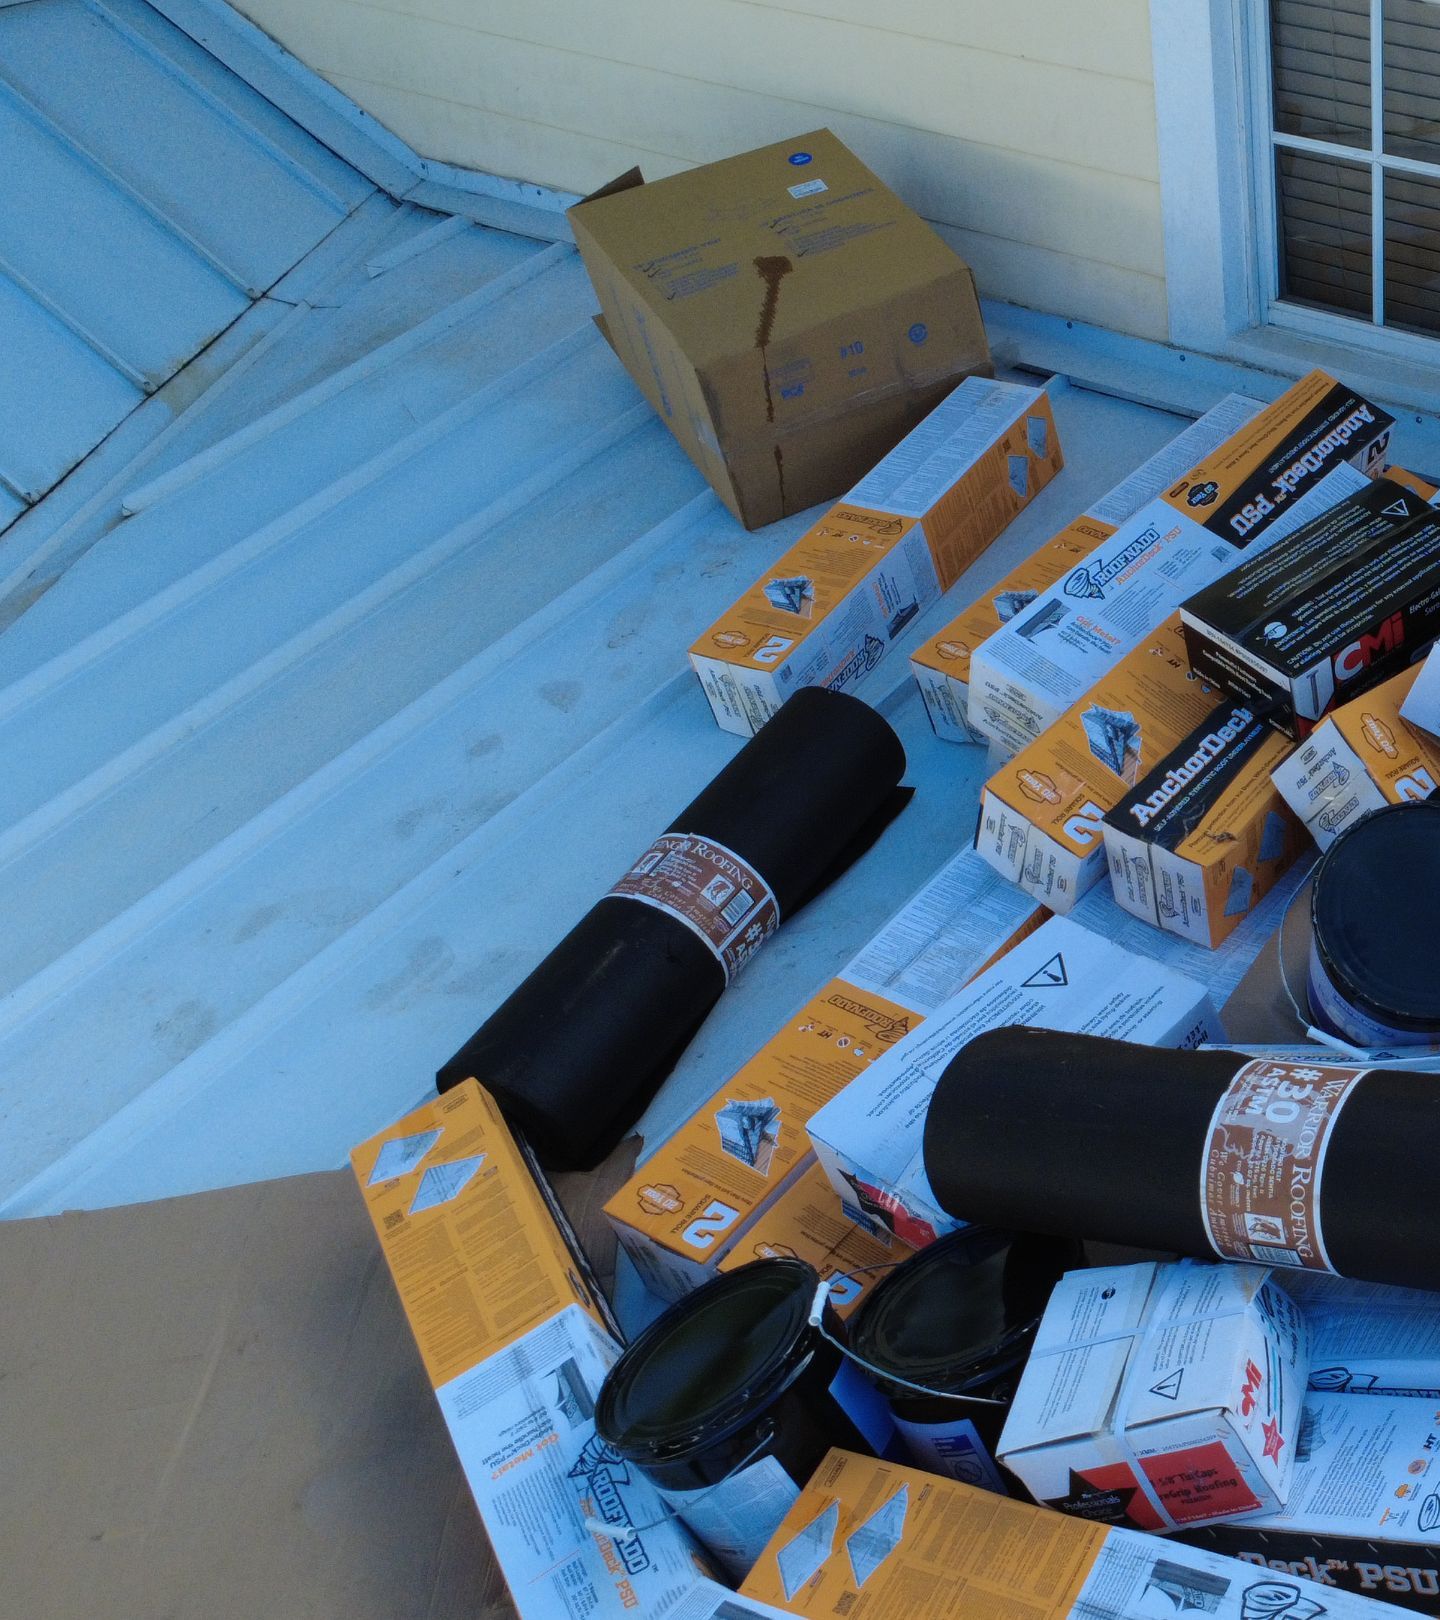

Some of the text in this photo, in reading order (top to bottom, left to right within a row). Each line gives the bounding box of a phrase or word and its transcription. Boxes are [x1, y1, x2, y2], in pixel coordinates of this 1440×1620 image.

[1188, 480, 1215, 506] 20 Year
[1226, 490, 1275, 538] PSU
[1162, 524, 1183, 544] PSU
[751, 636, 795, 664] 2
[1126, 701, 1259, 827] AnchorDeck
[1062, 800, 1106, 846] 2
[692, 842, 754, 890] ROOFING
[825, 990, 895, 1030] ROOFNADO
[815, 1027, 833, 1041] HT
[1244, 1067, 1281, 1117] ASTM
[1266, 1067, 1324, 1124] #30
[1289, 1078, 1350, 1259] WARRIOR ROOFING
[641, 1186, 678, 1211] 20 Year
[681, 1199, 740, 1250] 2
[1063, 1494, 1121, 1513] Professionals
[1194, 1476, 1238, 1494] Roofing
[614, 1577, 640, 1610] PSU
[1354, 1561, 1440, 1596] PSU
